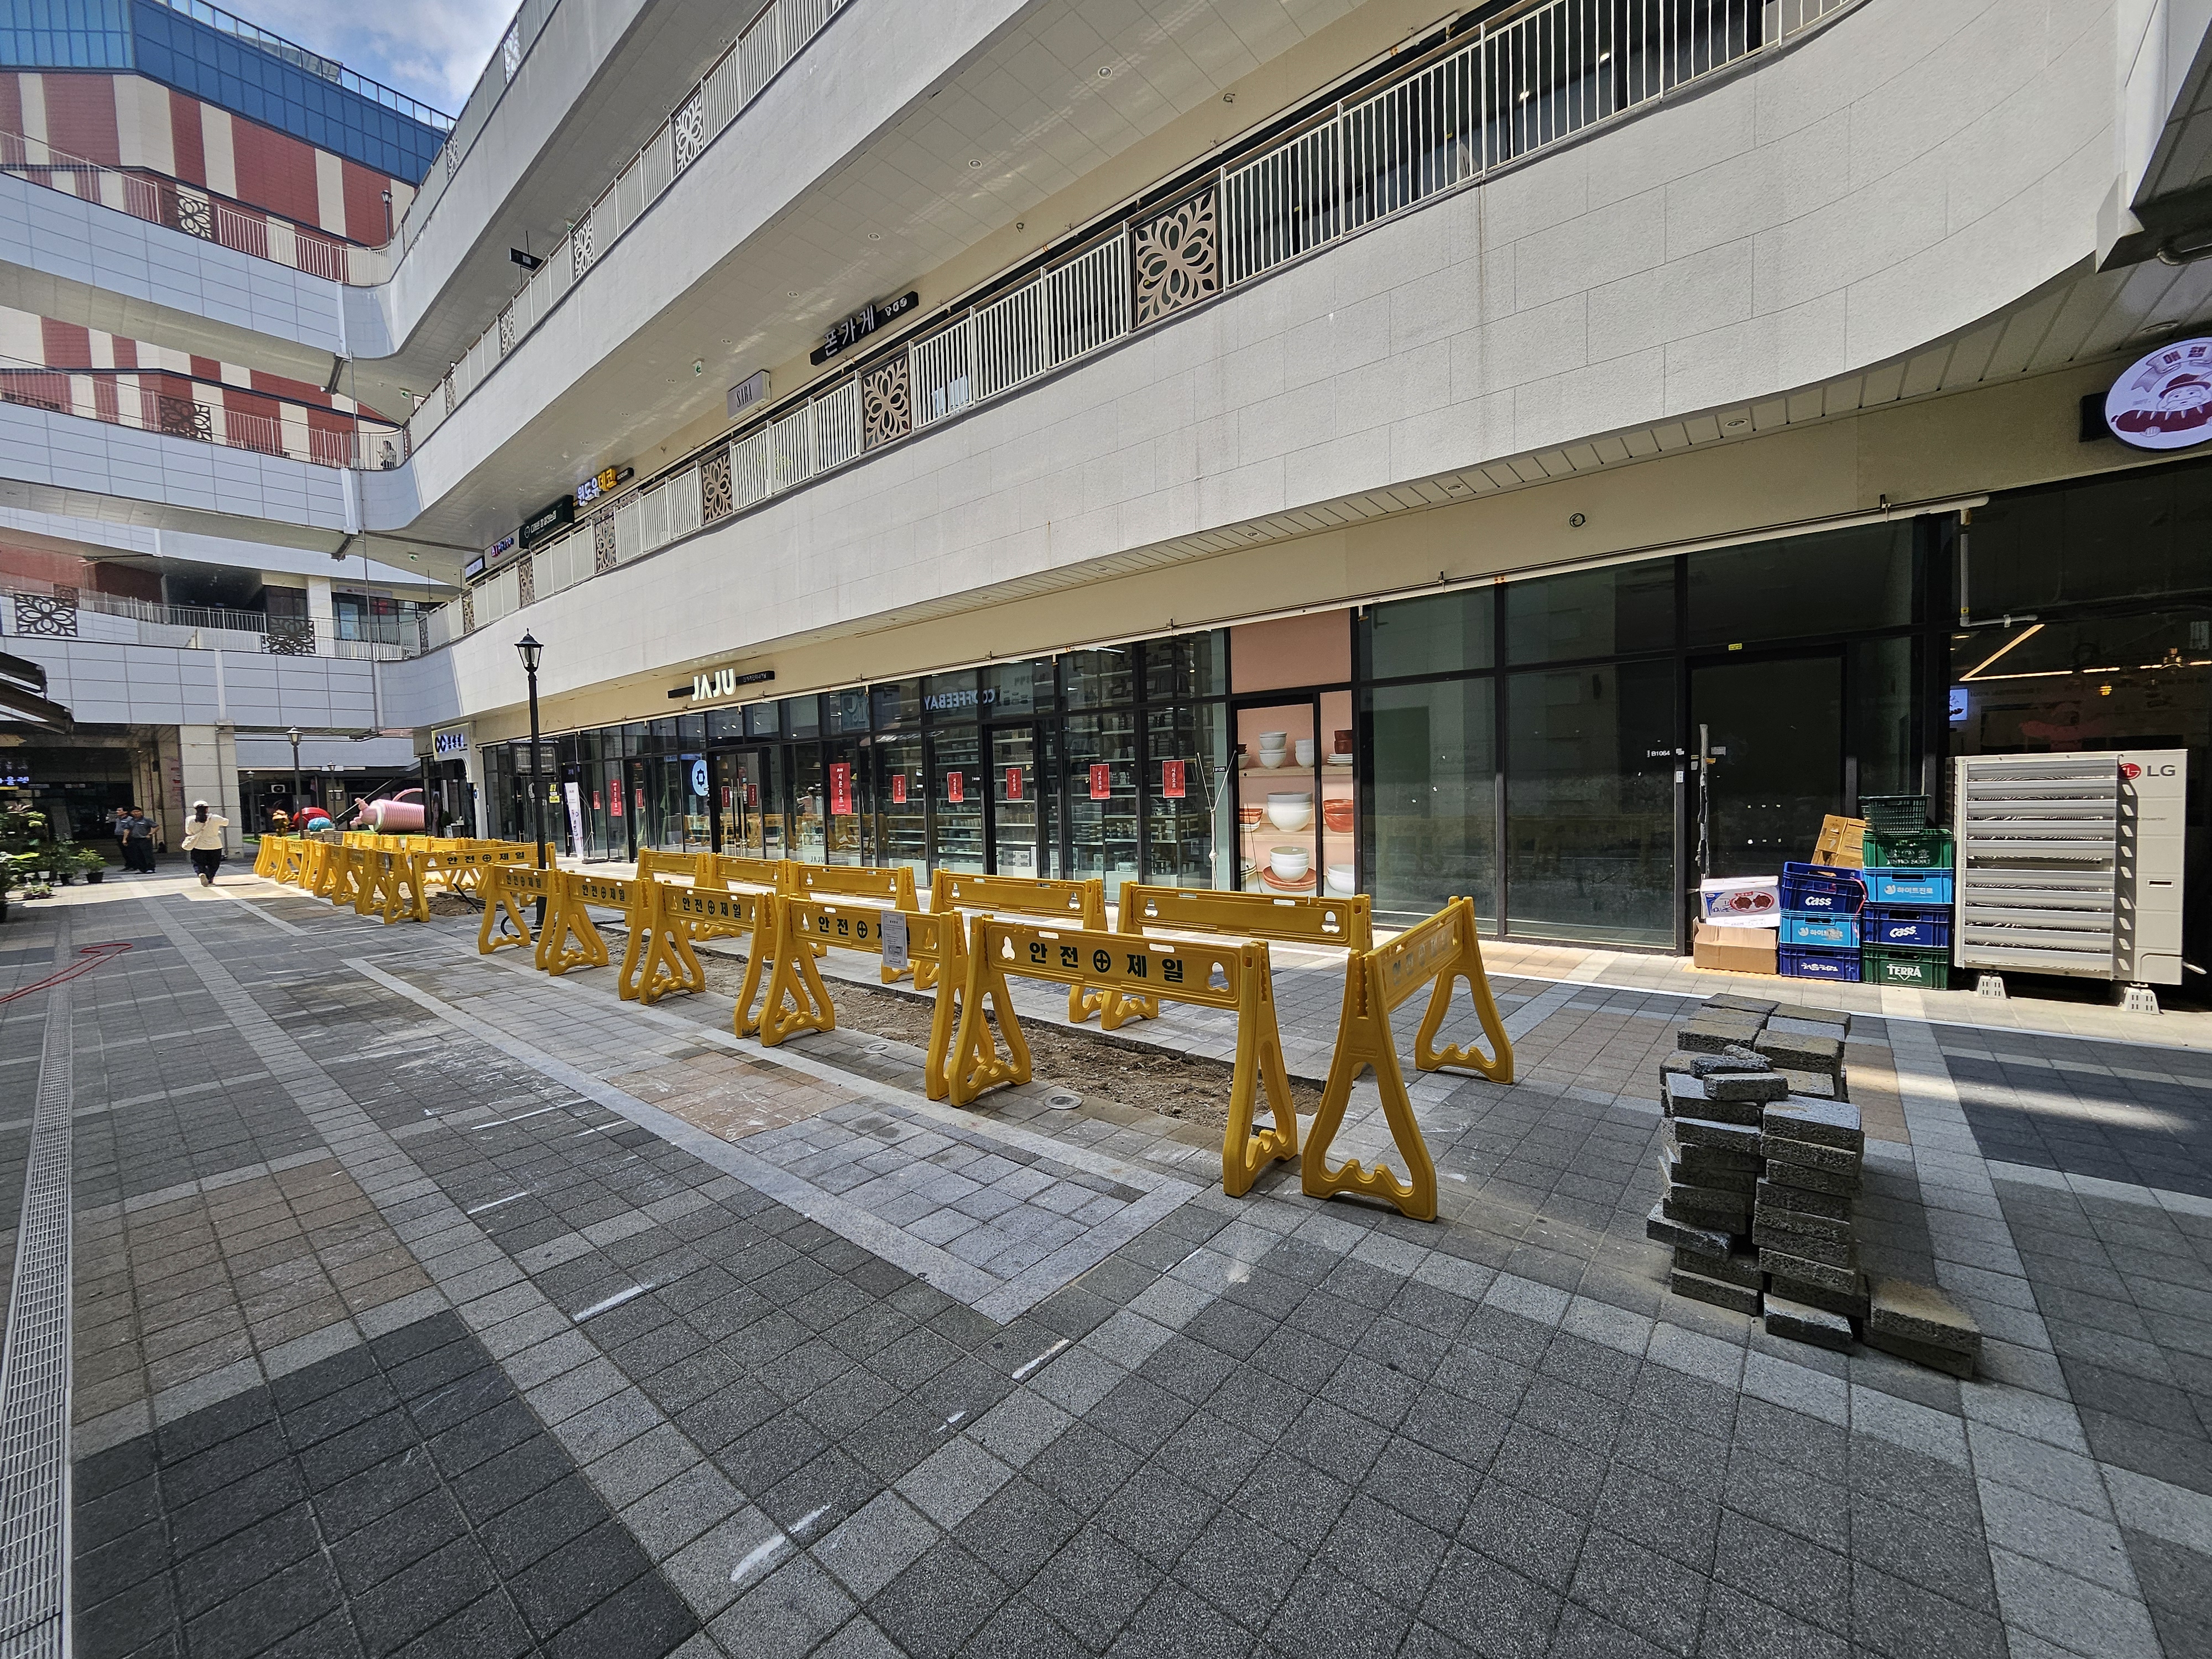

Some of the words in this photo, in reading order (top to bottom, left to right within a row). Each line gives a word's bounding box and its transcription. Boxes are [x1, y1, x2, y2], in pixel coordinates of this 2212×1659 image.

[824, 305, 875, 357] 폰가게
[736, 383, 753, 408] SARA
[692, 668, 737, 701] JAJU
[2147, 764, 2176, 777] LG
[446, 855, 476, 865] 안전
[499, 851, 525, 861] 제일
[505, 874, 519, 886] 안전
[527, 877, 541, 889] 제일
[582, 885, 598, 898] 안전
[609, 888, 625, 902] 제일
[1897, 886, 1934, 895] 하이트진로
[682, 898, 703, 912] 안전
[720, 902, 742, 919] 제일
[1805, 896, 1833, 906] Cass
[818, 916, 849, 936] 안전
[1889, 925, 1917, 938] Cass
[1029, 942, 1079, 968] 안전
[1126, 953, 1183, 983] 제일
[1886, 964, 1922, 978] TERRA
